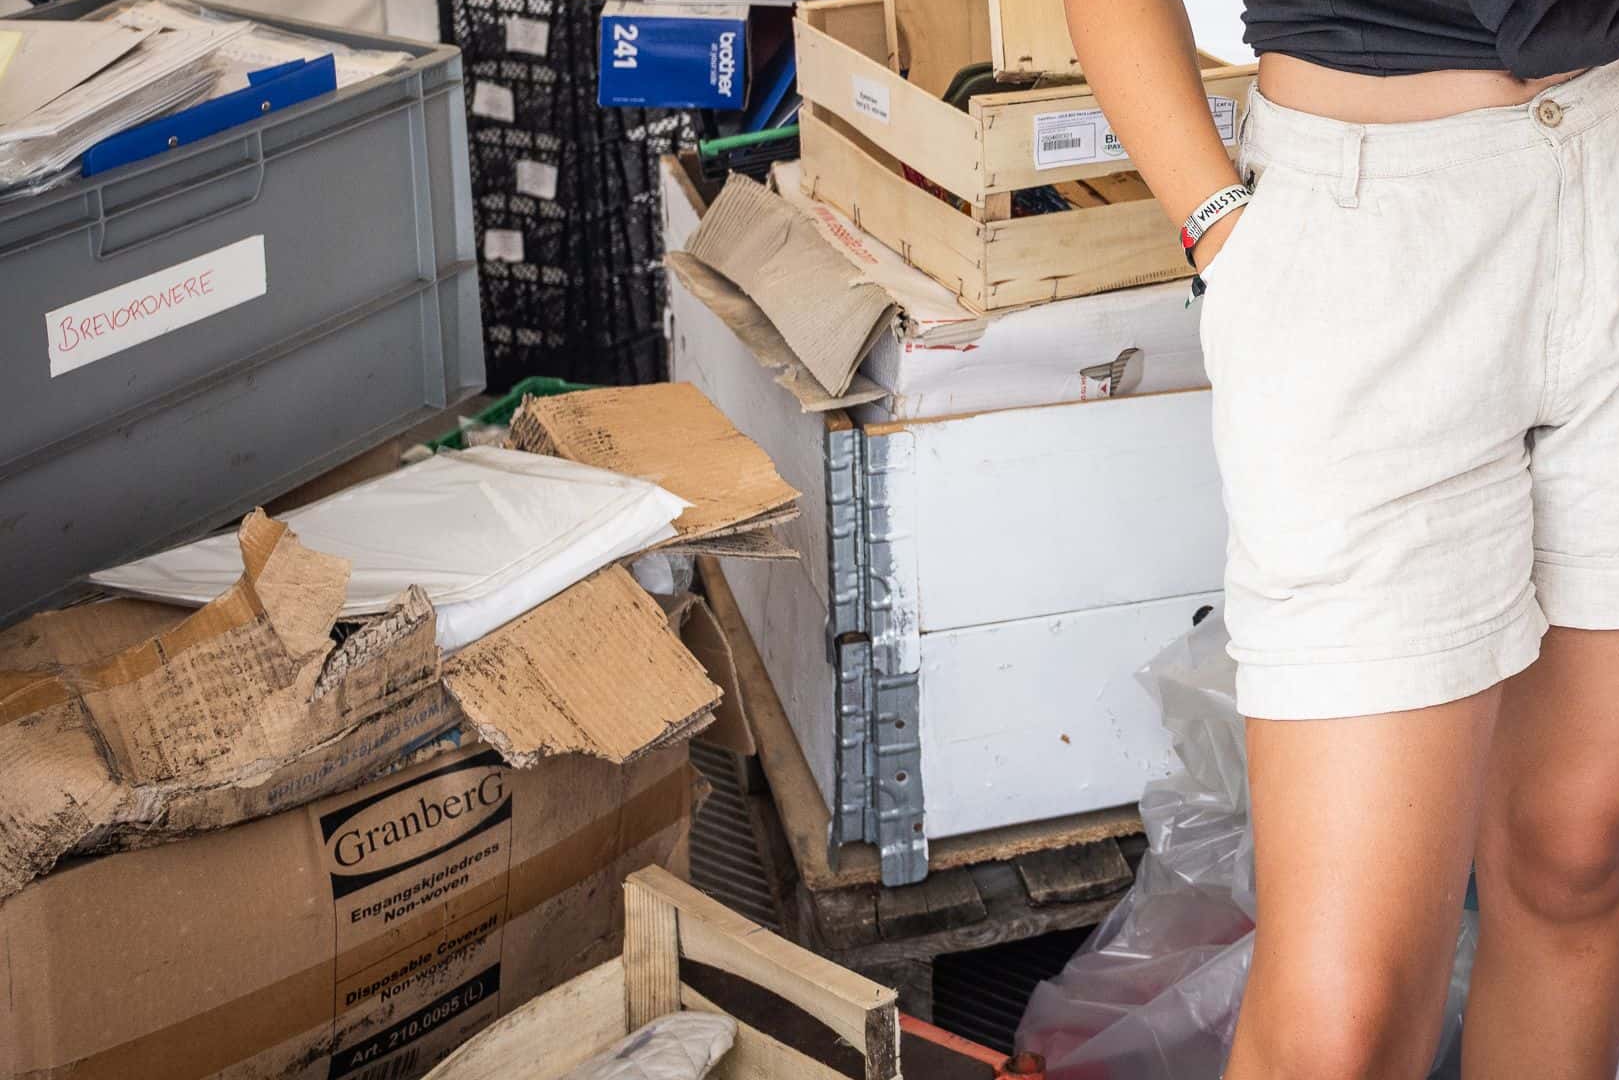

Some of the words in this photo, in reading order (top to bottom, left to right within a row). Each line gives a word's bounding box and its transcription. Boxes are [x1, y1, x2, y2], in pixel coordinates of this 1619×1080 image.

[613, 24, 639, 69] 241
[718, 32, 737, 98] brother
[1197, 186, 1252, 222] ALESTINA
[58, 269, 215, 352] BREVORDNERE
[334, 772, 503, 867] GranberG
[384, 873, 469, 924] Non-woven
[345, 952, 433, 1007] Disposable
[437, 914, 498, 956] Coverall
[352, 1042, 382, 1066] Art.
[389, 997, 459, 1044] 210.0095
[464, 981, 485, 1007] (L)
